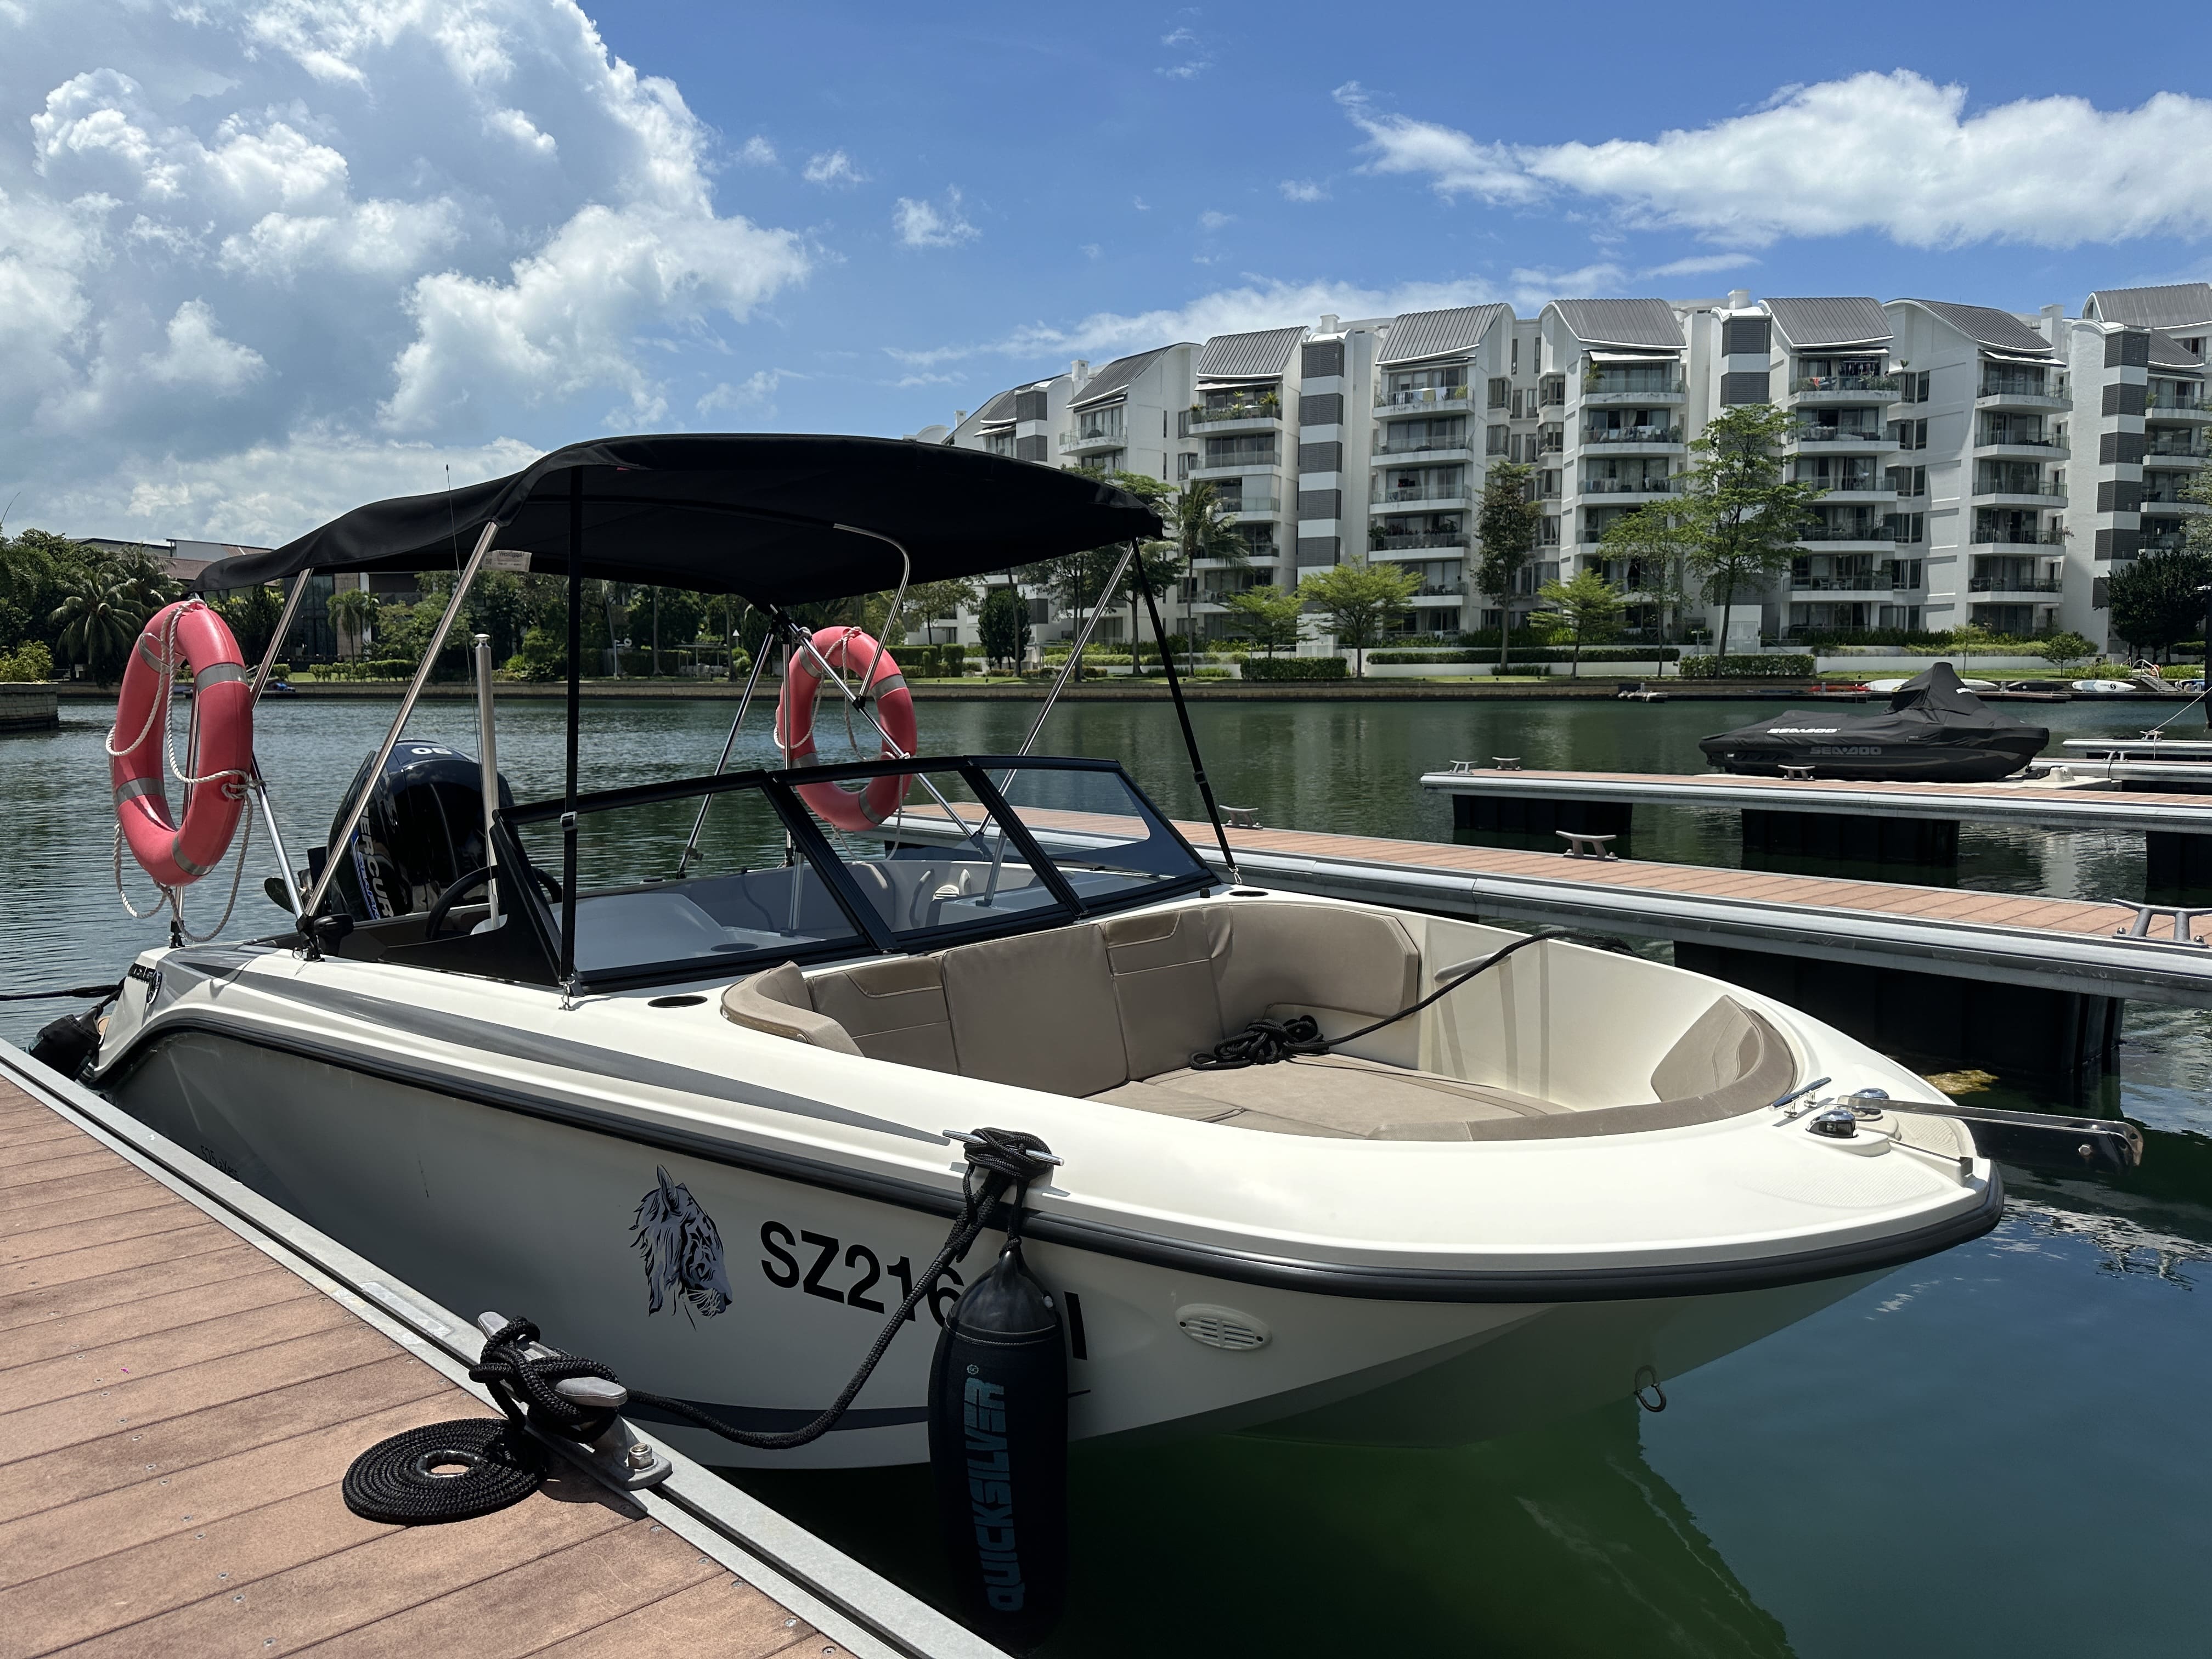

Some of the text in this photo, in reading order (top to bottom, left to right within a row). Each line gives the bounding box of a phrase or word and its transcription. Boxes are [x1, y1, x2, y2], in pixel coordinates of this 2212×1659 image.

[357, 850, 381, 920] SEAPR
[359, 806, 394, 918] ERCUR
[963, 1376, 1026, 1612] QUICKSILVER
